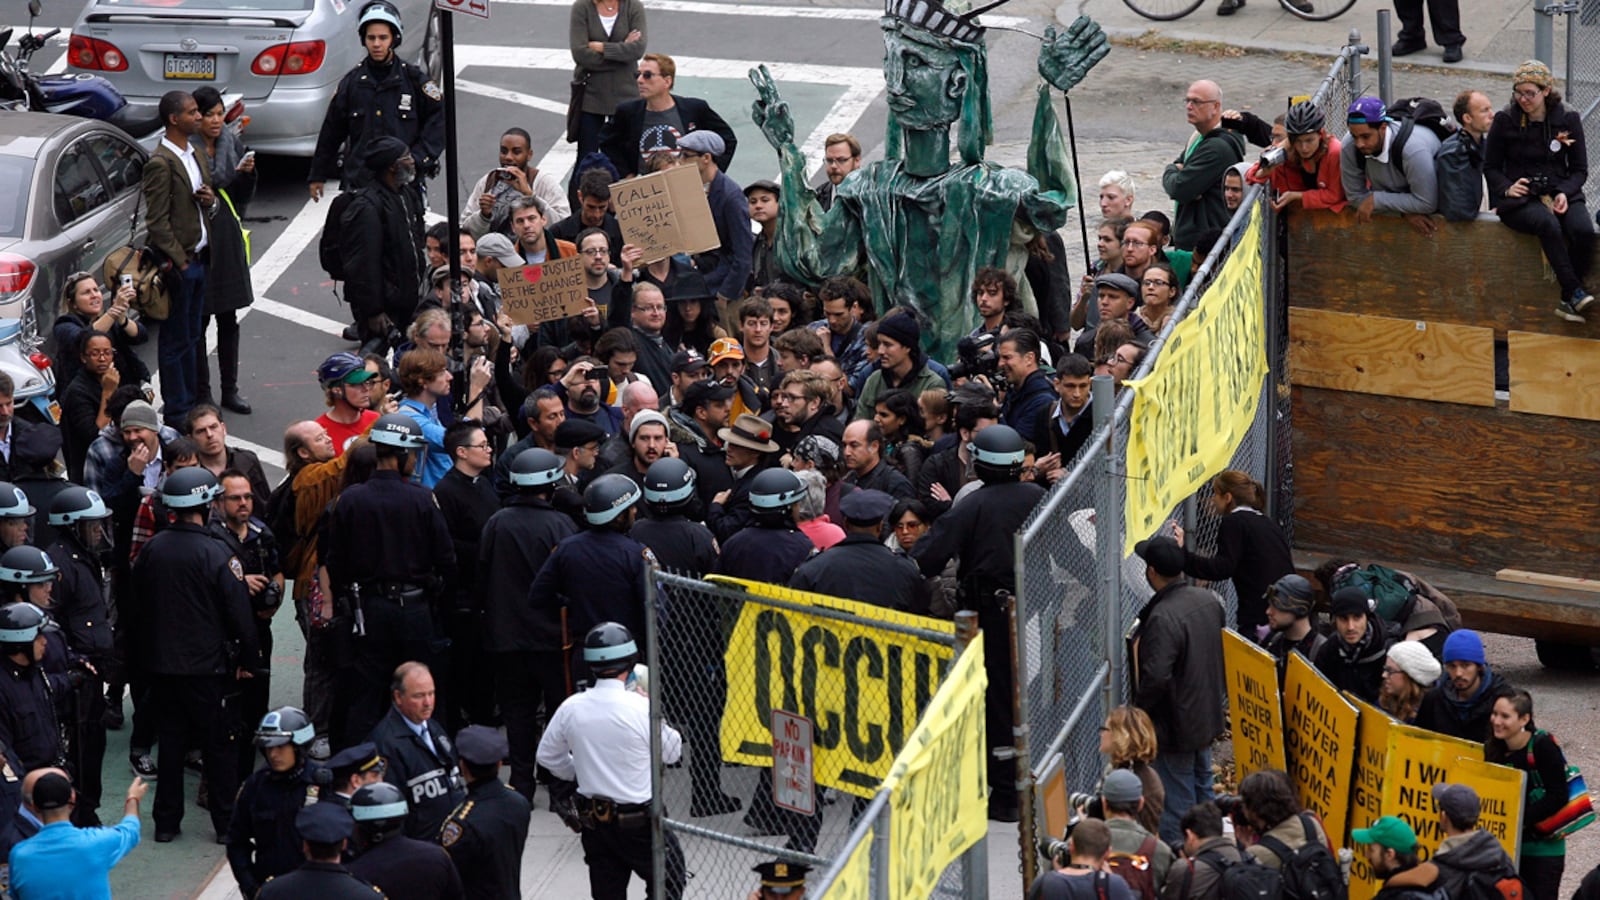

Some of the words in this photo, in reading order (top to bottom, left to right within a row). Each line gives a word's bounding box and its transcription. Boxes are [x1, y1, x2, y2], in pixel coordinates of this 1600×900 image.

[617, 184, 663, 208] CALL
[620, 206, 643, 221] CITY
[503, 270, 523, 284] WE
[542, 258, 581, 277] JUSTICE
[502, 288, 514, 299] BE
[517, 284, 536, 297] THE
[540, 273, 583, 293] CHANGE
[507, 299, 528, 312] YOU
[532, 291, 562, 308] WANT
[568, 289, 582, 302] TO
[1236, 669, 1242, 689] I
[1242, 673, 1270, 705] WILL
[1237, 693, 1274, 730] NEVER
[1295, 683, 1302, 701] I
[1306, 690, 1340, 739] WILL
[784, 720, 800, 742] NO
[1240, 717, 1262, 746] GET
[1265, 732, 1275, 753] A
[1291, 703, 1340, 762] NEVER
[1288, 727, 1324, 774] OWN
[1326, 765, 1336, 788] A
[1404, 759, 1411, 779] I
[411, 777, 449, 804] POL
[1357, 764, 1384, 792] NEV
